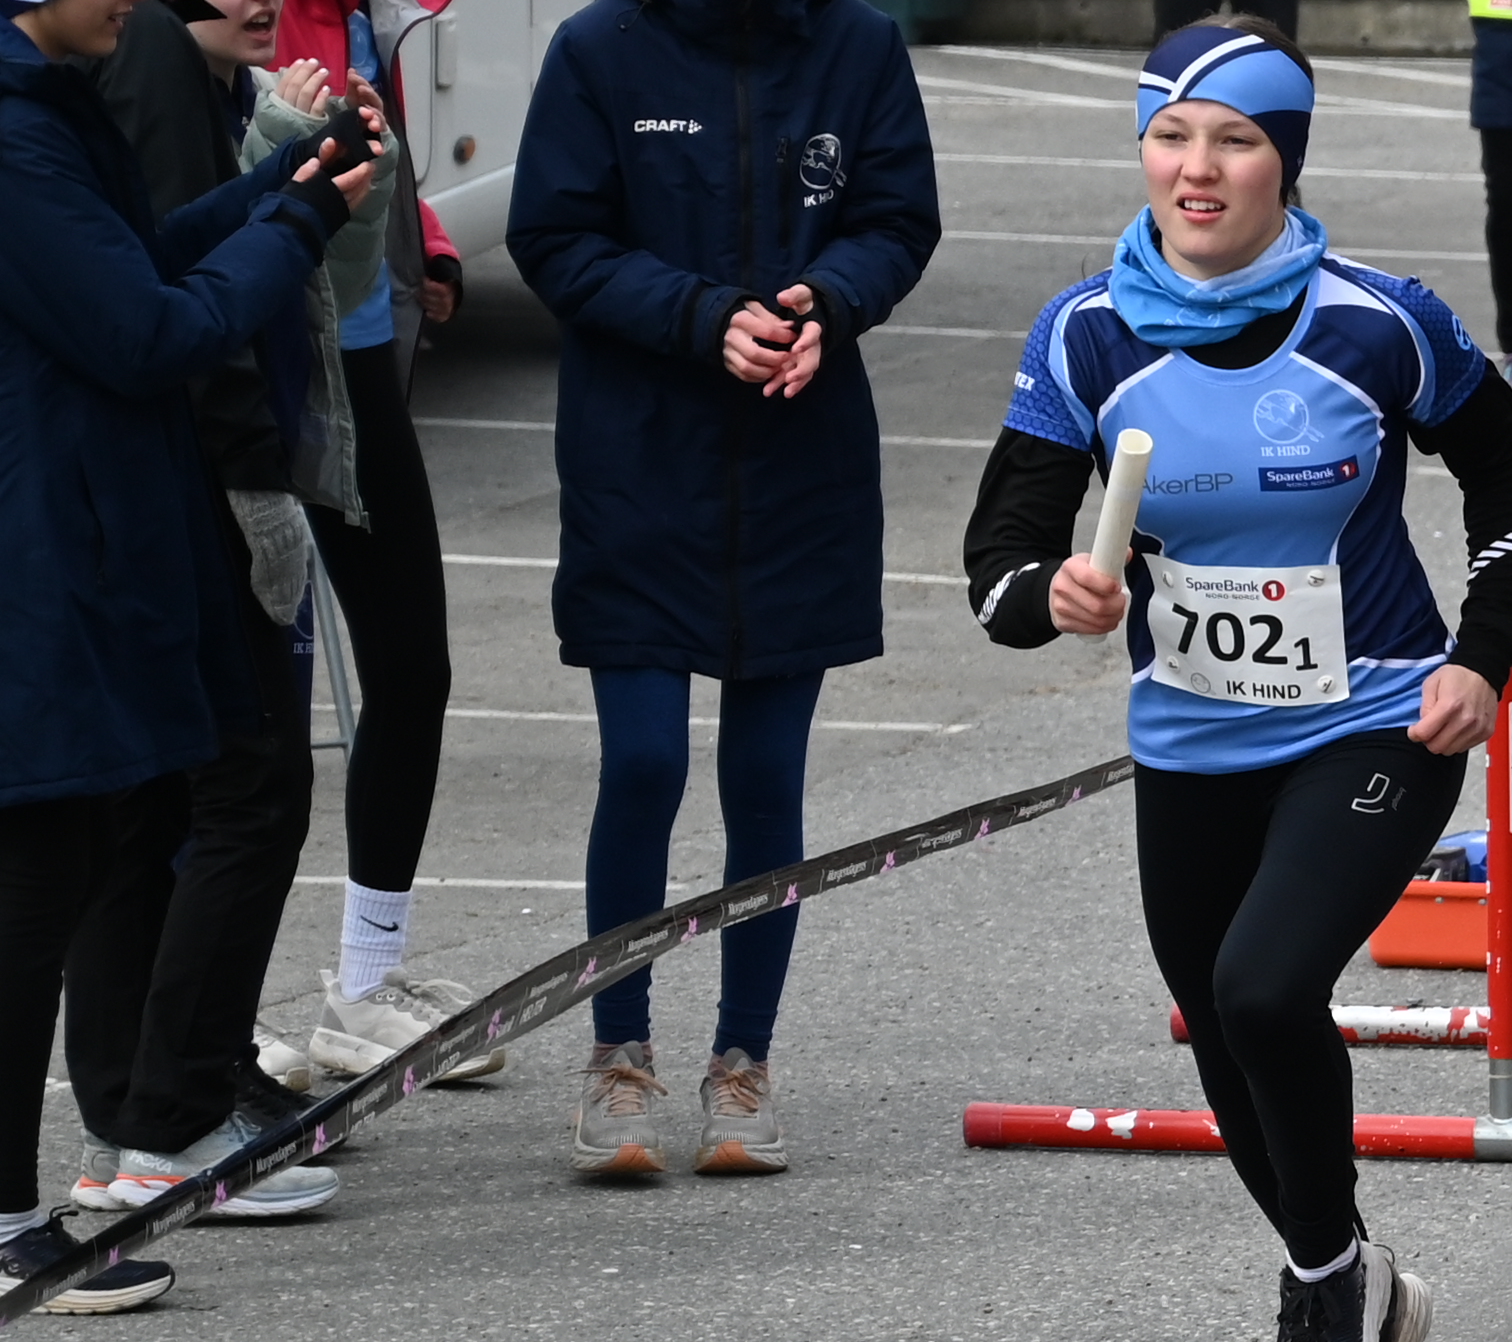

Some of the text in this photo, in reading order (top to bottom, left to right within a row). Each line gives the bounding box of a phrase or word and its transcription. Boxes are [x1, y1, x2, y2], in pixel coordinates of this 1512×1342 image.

[634, 119, 686, 133] CRAFT
[1260, 444, 1311, 457] IK HIND
[1266, 467, 1335, 484] SpareBank
[1185, 577, 1259, 593] SpareBank
[1226, 680, 1302, 699] IK HIND
